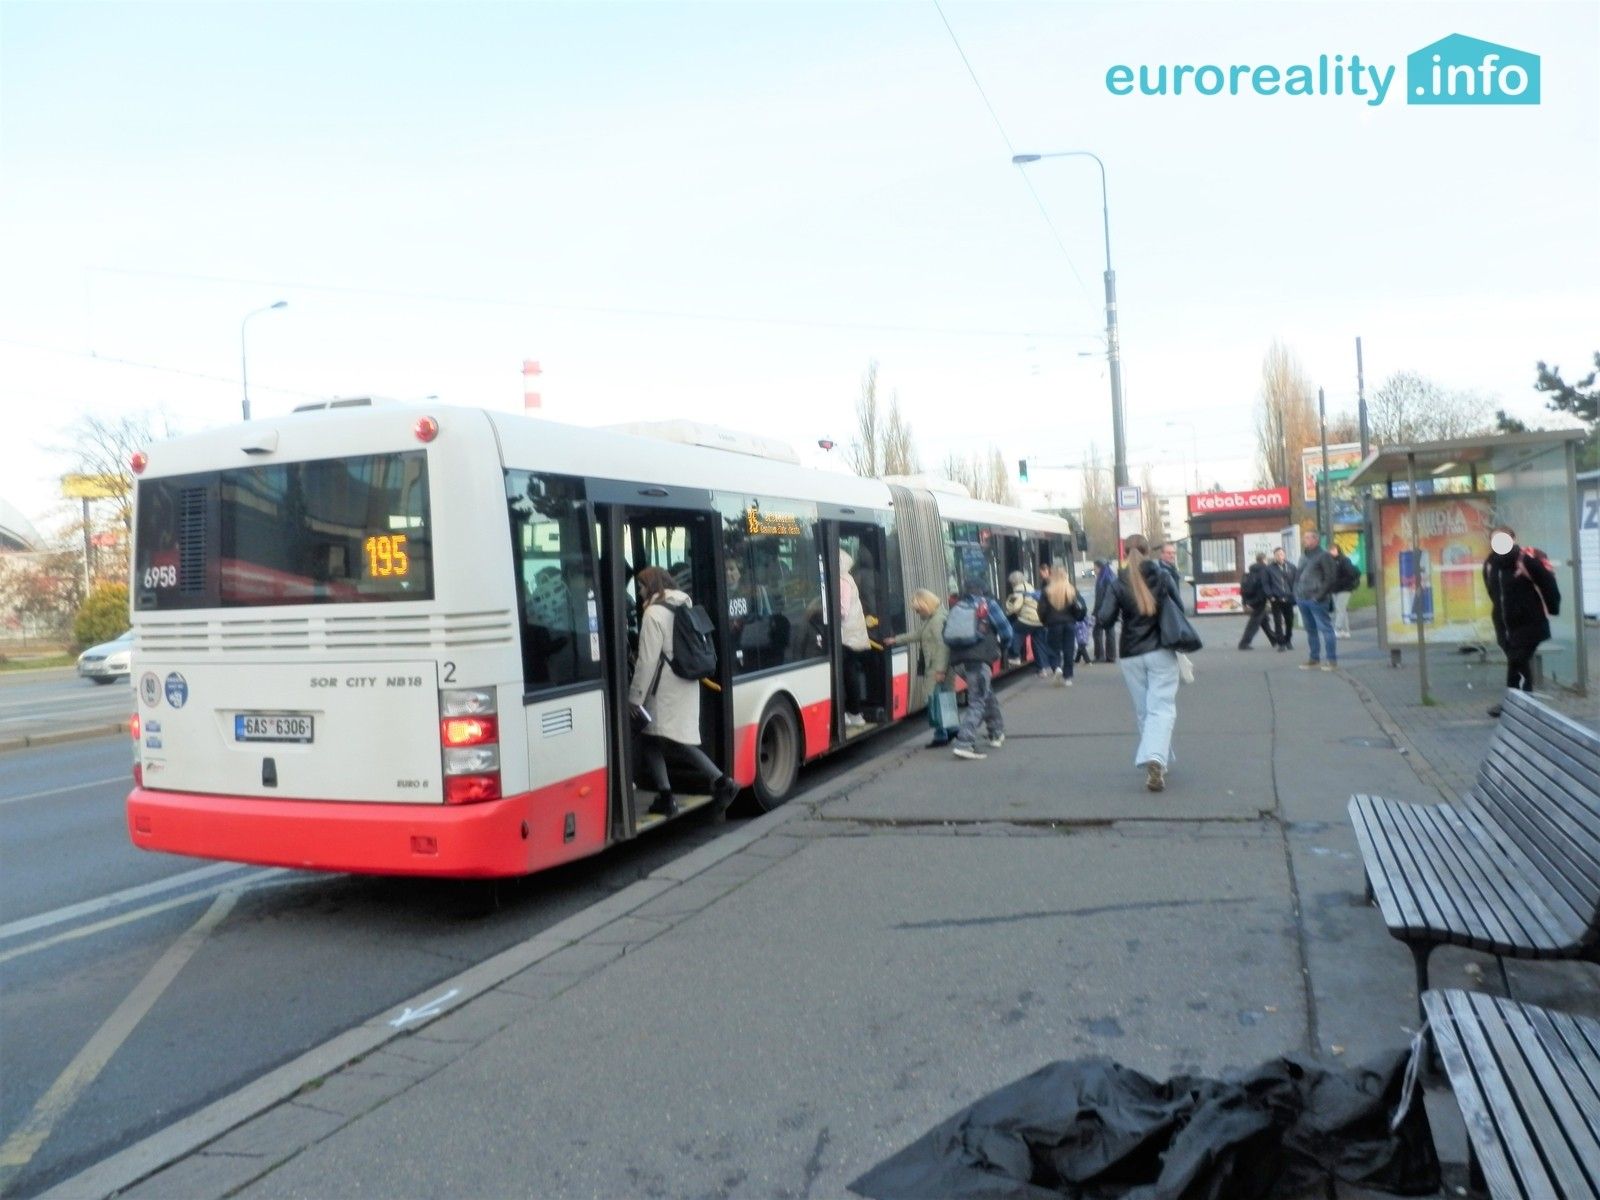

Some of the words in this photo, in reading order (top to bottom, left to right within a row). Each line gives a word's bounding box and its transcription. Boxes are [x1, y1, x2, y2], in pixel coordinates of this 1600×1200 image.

[1196, 492, 1283, 509] Kebab.com
[366, 534, 408, 577] 195
[144, 564, 177, 589] 6958
[729, 597, 748, 617] 6958
[443, 661, 457, 683] 2
[310, 677, 338, 688] SOR
[346, 677, 377, 688] CITY
[386, 676, 423, 687] NB18
[246, 718, 268, 734] 6AS
[276, 718, 307, 735] 6306
[396, 779, 420, 788] EURO
